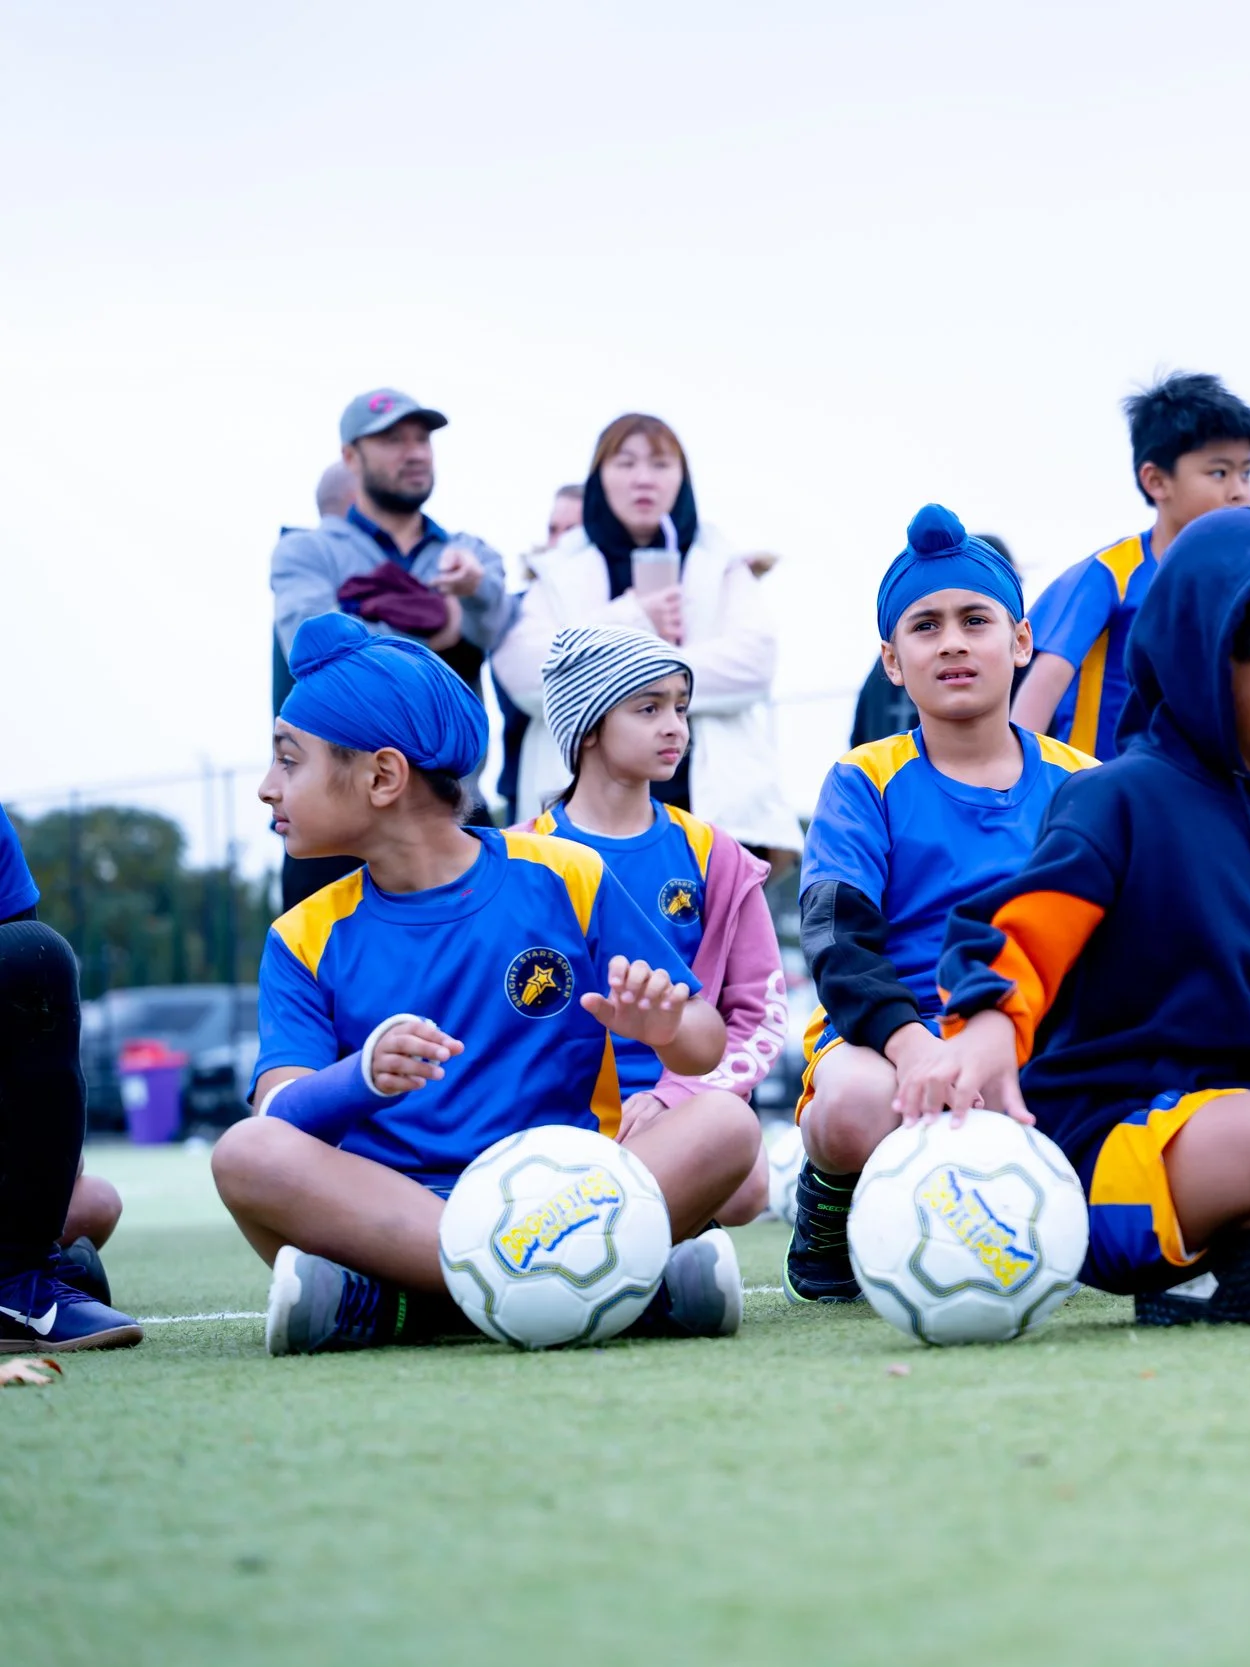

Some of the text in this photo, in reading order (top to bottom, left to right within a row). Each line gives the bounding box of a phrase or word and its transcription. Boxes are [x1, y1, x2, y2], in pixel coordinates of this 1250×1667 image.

[508, 950, 572, 1007] BRIGHT STARS SOCCER
[817, 1203, 851, 1212] SKECH
